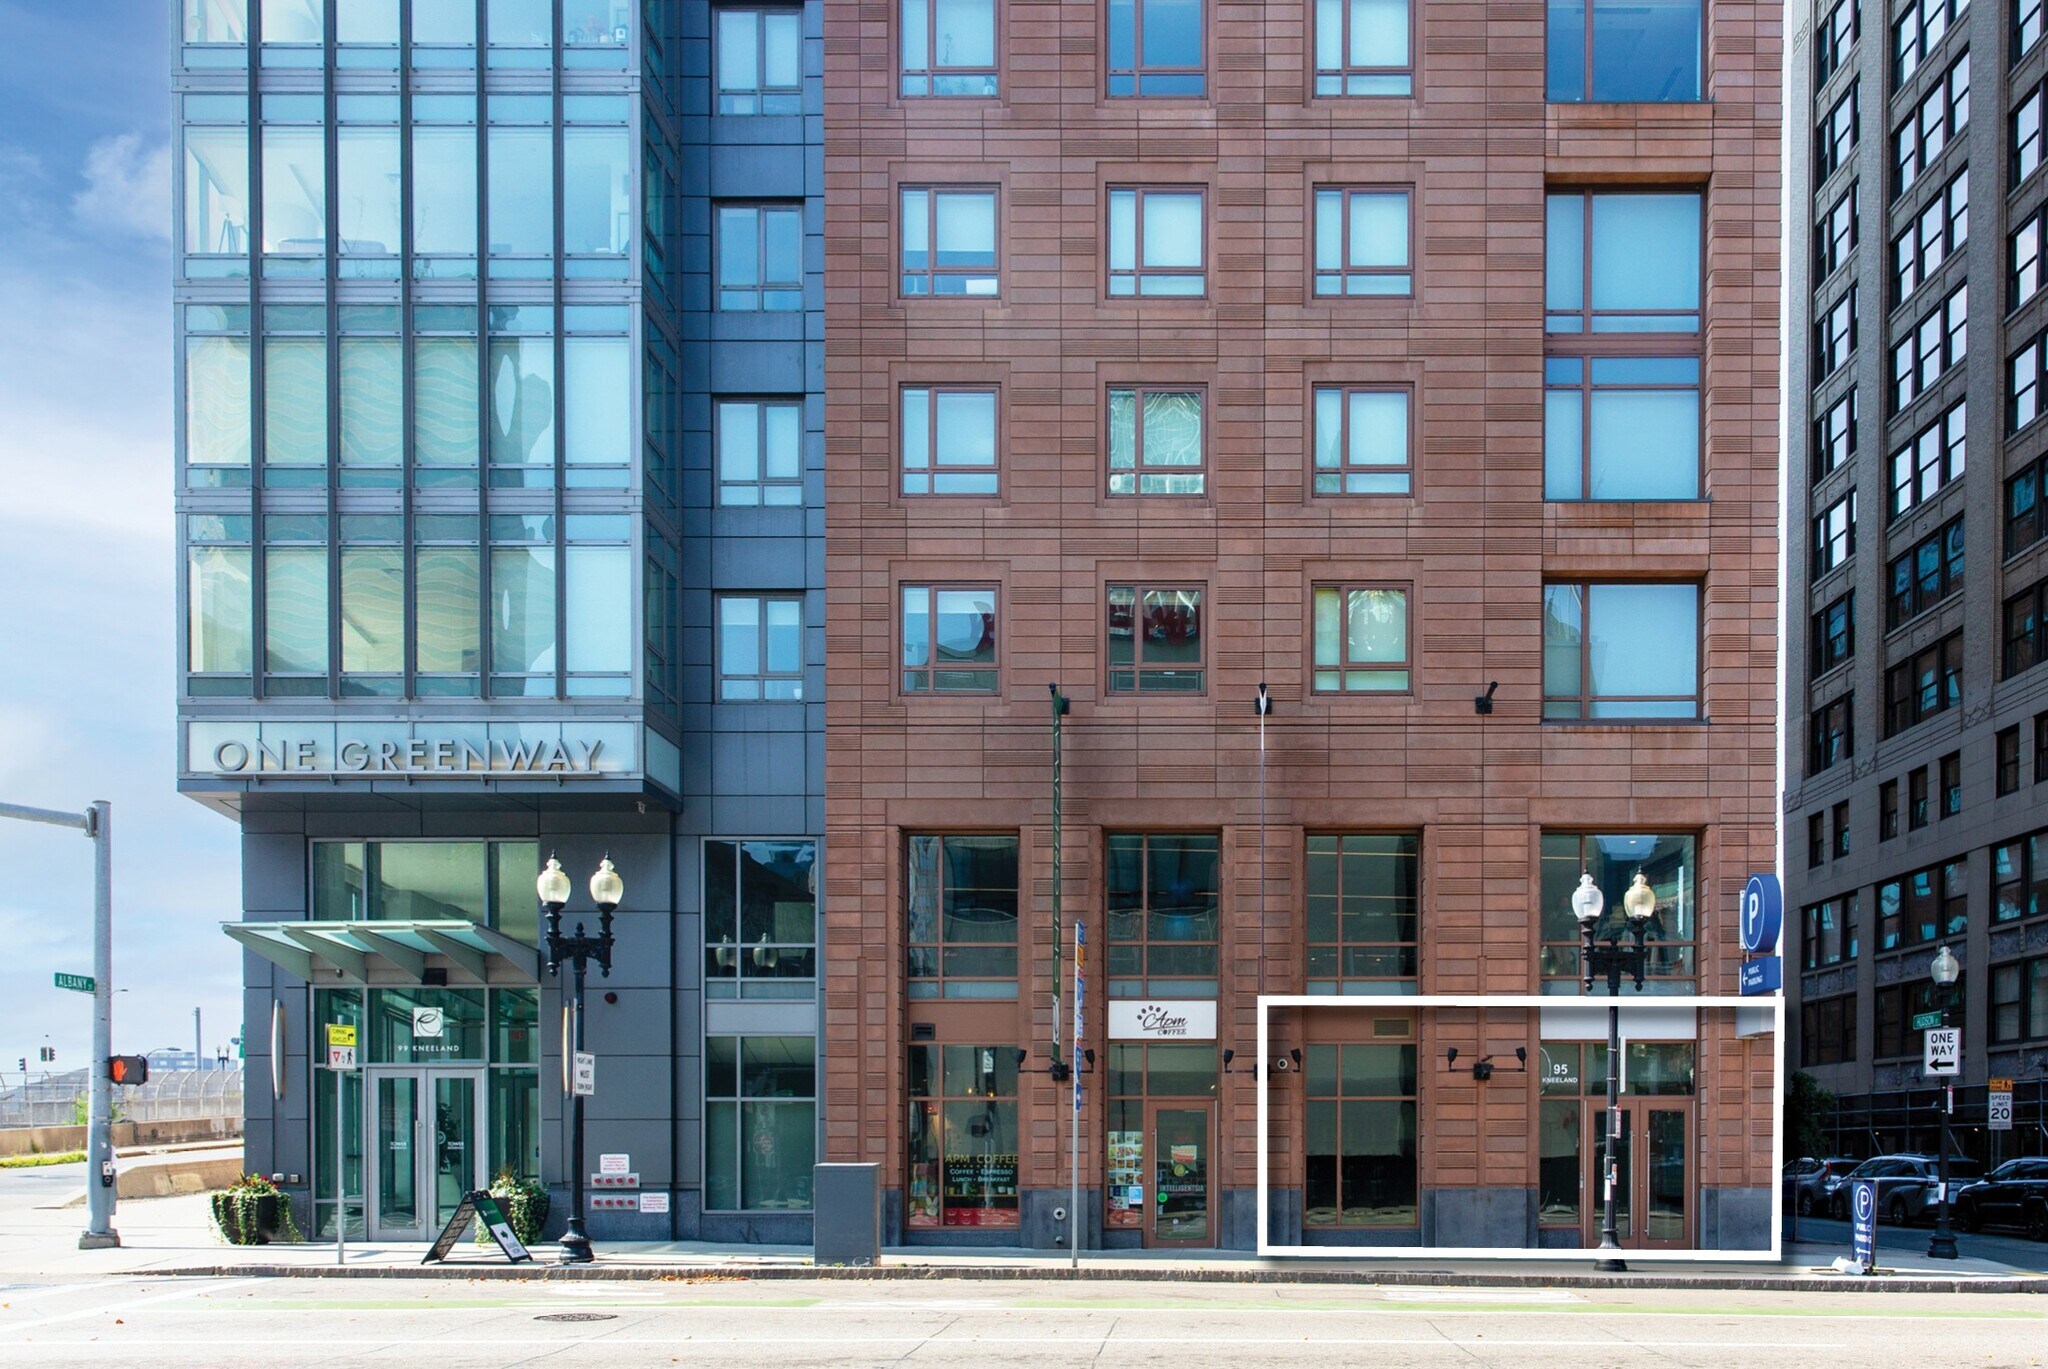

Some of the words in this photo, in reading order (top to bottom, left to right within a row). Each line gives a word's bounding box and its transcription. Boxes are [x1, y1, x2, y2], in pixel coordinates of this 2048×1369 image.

[213, 738, 317, 771] ONE
[341, 737, 602, 771] GREENWAY
[1749, 892, 1759, 935] P
[1747, 965, 1760, 975] PUBLIC
[59, 975, 87, 989] ALBANY
[1747, 975, 1763, 986] PARKING
[1916, 1015, 1935, 1027] HUDSON
[1157, 1028, 1187, 1036] COFFEE
[1930, 1032, 1954, 1044] ONE
[397, 1044, 409, 1052] 99
[412, 1044, 460, 1052] KNEELAND
[1930, 1045, 1955, 1056] WAY
[1553, 1063, 1568, 1075] 95
[1990, 1107, 2010, 1120] 20
[944, 1153, 970, 1163] APM
[976, 1153, 1018, 1164] COFFEE
[1861, 1191, 1870, 1214] P
